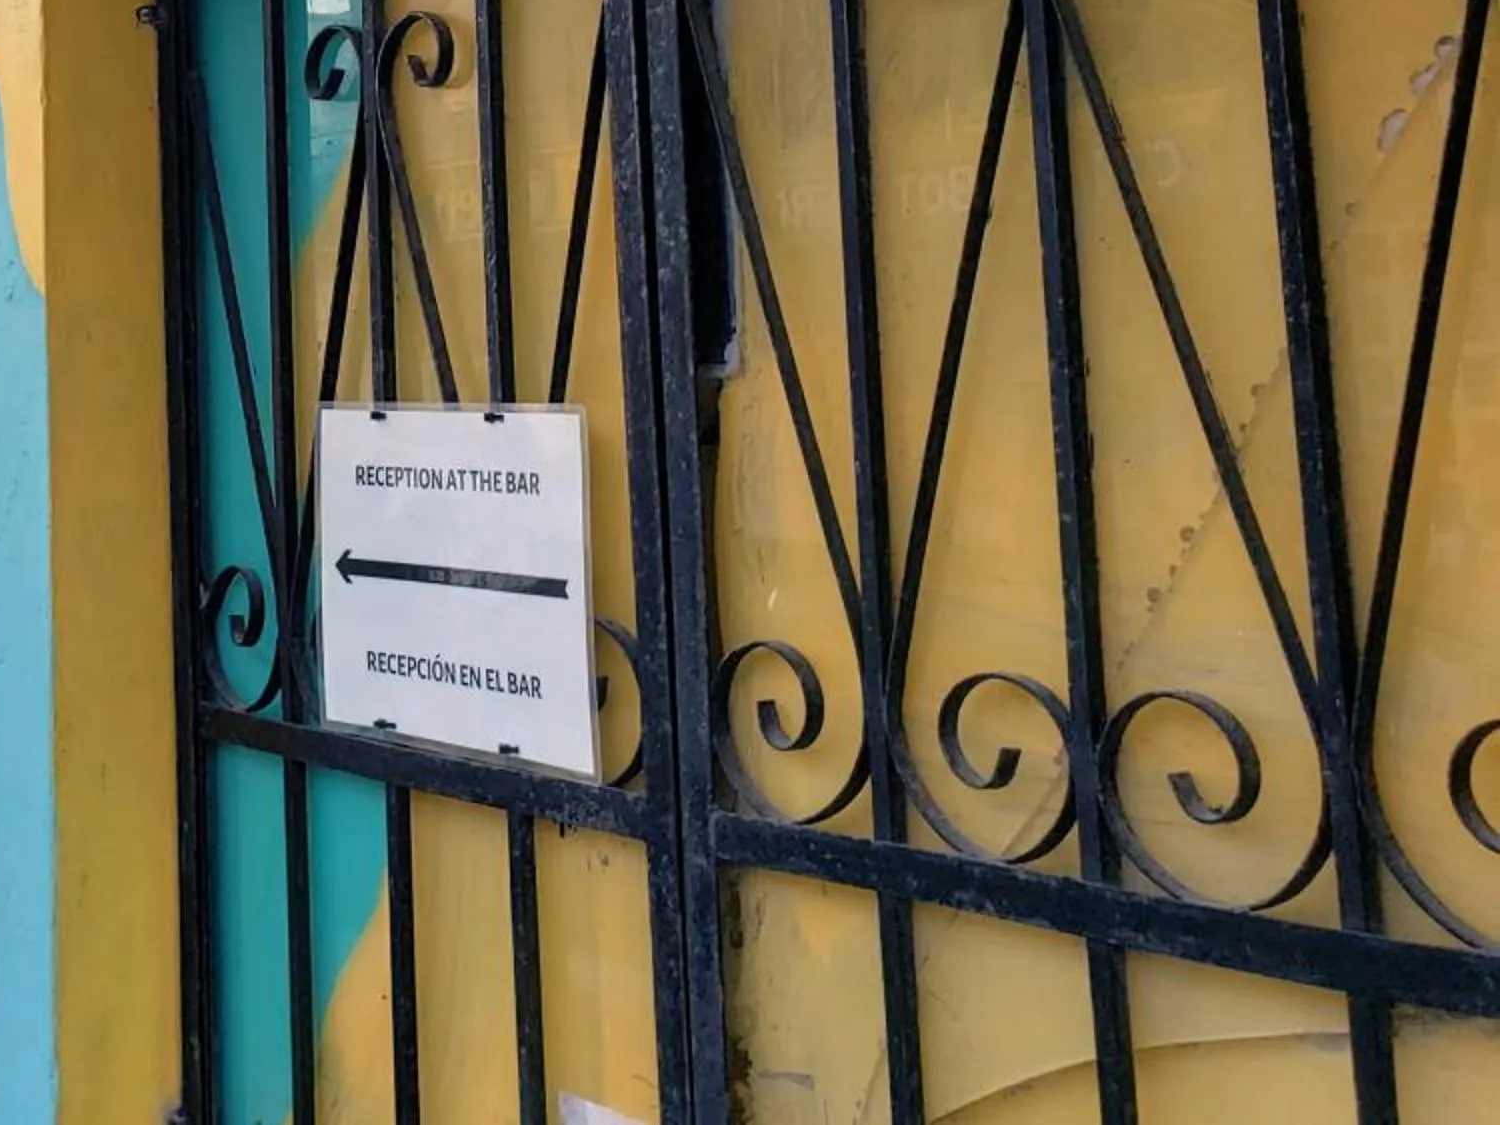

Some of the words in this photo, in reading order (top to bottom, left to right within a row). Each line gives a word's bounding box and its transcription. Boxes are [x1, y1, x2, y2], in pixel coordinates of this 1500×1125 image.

[355, 465, 443, 490] RECEPTION
[446, 467, 467, 491] AT
[470, 470, 503, 493] THE
[506, 472, 540, 496] BAR
[367, 650, 456, 685] RECEPCIÓN
[460, 664, 481, 690] EN
[486, 668, 504, 693] EL
[507, 672, 542, 699] BAR
